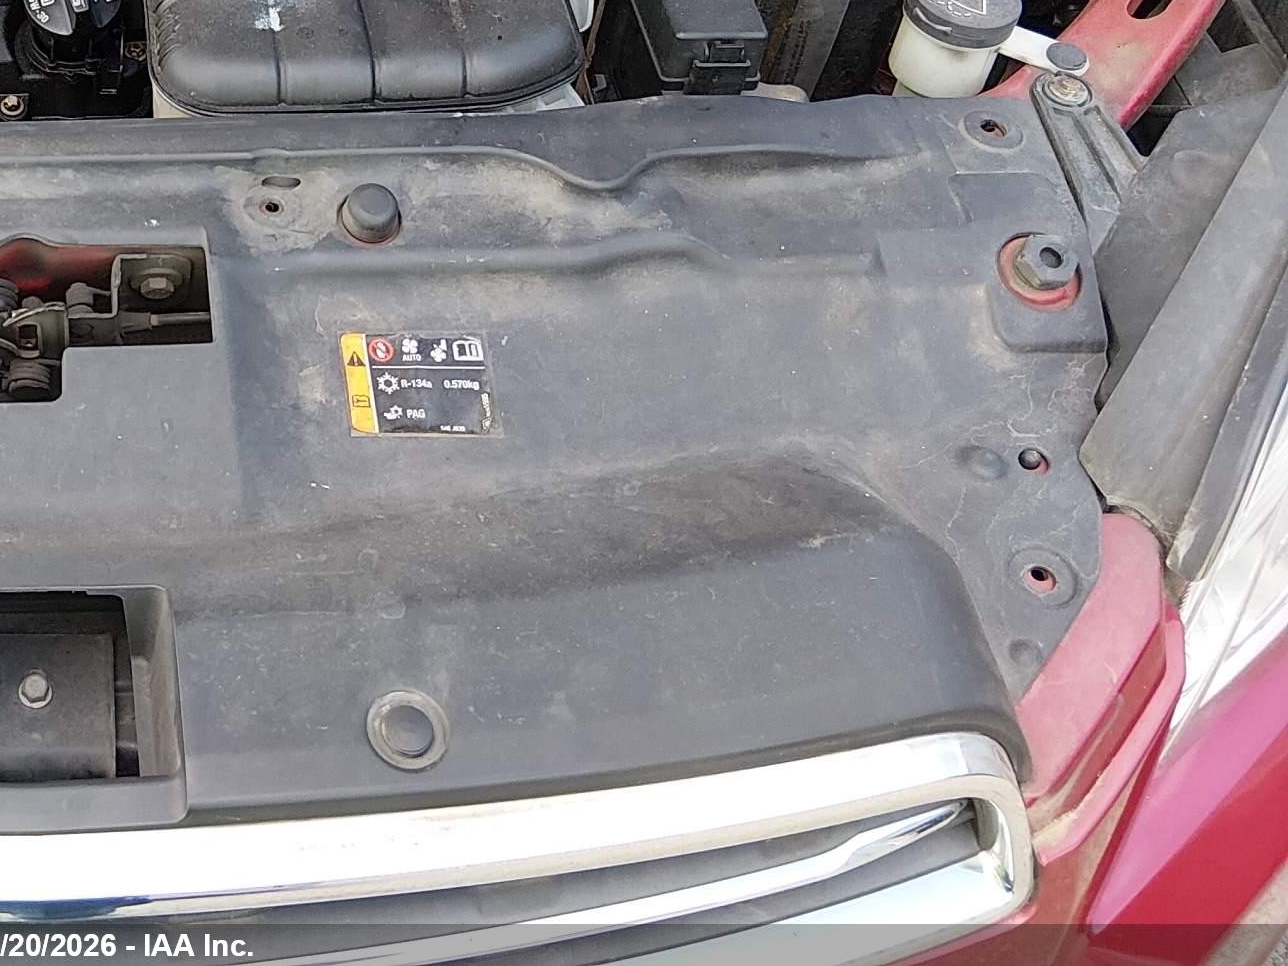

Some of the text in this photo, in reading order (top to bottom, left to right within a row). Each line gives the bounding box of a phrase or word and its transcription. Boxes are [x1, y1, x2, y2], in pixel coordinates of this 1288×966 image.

[402, 354, 422, 362] AUTO
[400, 379, 480, 390] R-134a 0.570kg
[406, 409, 426, 419] PAG
